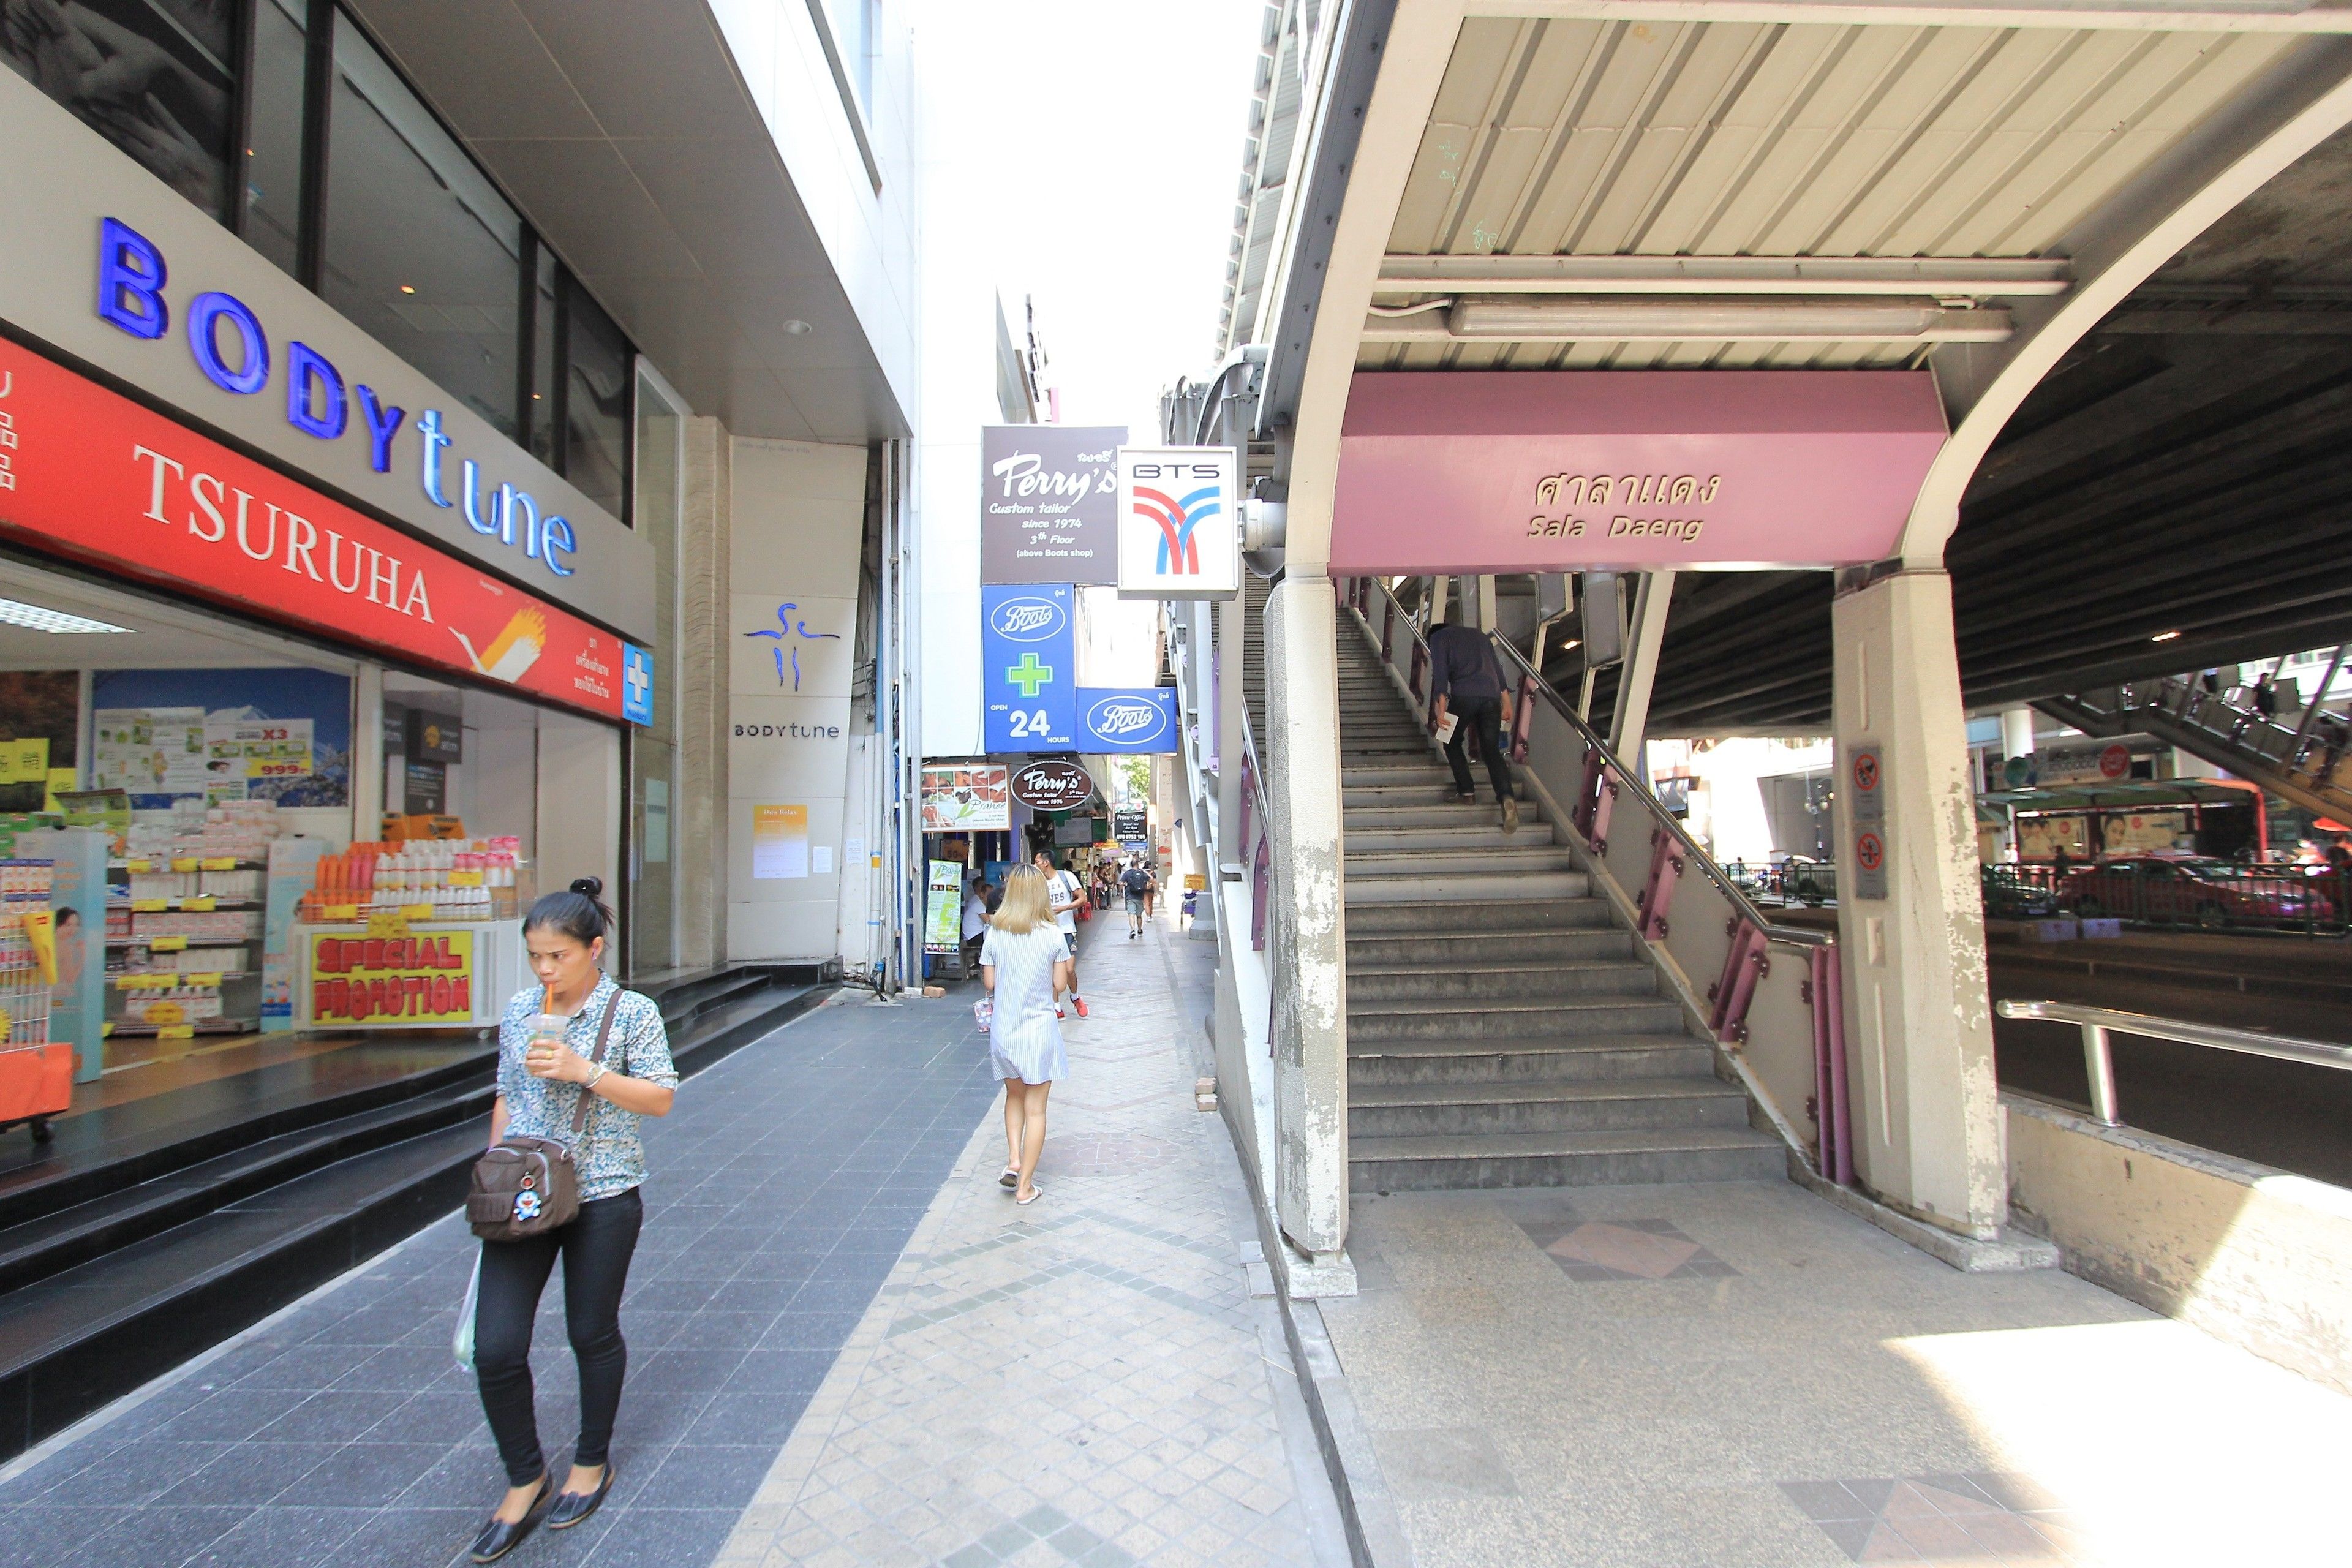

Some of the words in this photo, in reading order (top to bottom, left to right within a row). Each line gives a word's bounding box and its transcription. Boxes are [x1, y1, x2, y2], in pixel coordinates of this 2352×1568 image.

[98, 217, 576, 577] BODYtune
[992, 450, 1117, 506] Perry's
[1133, 464, 1220, 478] BTS
[1535, 472, 1722, 506] ศาลาแดง
[989, 502, 1035, 514] Custom
[1039, 502, 1071, 514] tailor
[133, 444, 435, 624] TSURUHA
[1022, 519, 1050, 529] since
[1054, 518, 1083, 529] 1974
[1030, 531, 1047, 545] 3th
[1050, 535, 1076, 544] Floor
[1527, 514, 1587, 538] Sala
[1608, 514, 1705, 543] Daeng
[1016, 549, 1043, 558] (above
[1070, 549, 1093, 558] shop)
[1000, 605, 1054, 633] Boots
[734, 722, 840, 738] BODYtune
[1009, 709, 1050, 738] 24
[1096, 704, 1154, 735] Boots
[1023, 769, 1079, 794] Perry's
[317, 937, 462, 973] SPECIAL
[314, 975, 469, 1020] PROMOTION
